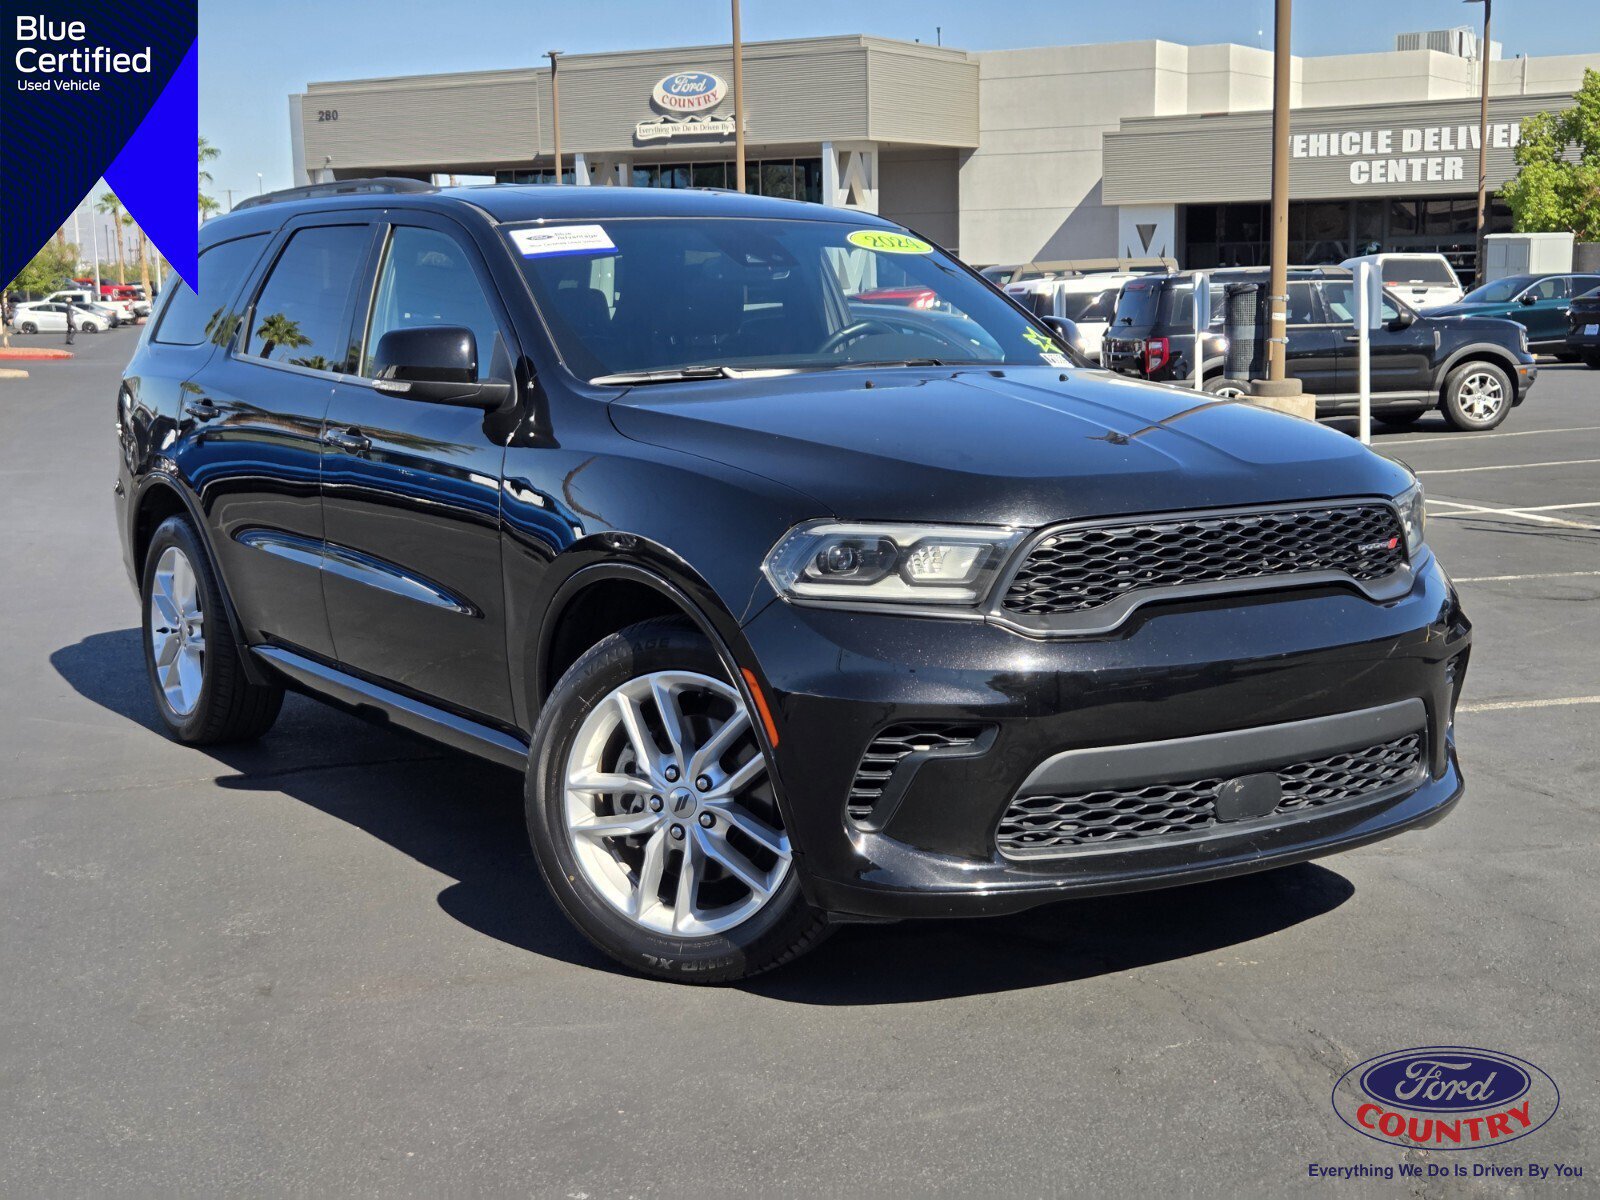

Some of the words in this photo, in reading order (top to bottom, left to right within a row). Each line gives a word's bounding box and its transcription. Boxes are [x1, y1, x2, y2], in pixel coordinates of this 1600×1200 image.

[671, 74, 707, 93] Ford
[661, 90, 719, 108] COUNTRY
[318, 109, 339, 122] 280
[639, 125, 670, 137] Everything
[671, 124, 681, 132] We
[682, 124, 692, 132] Do
[700, 123, 720, 132] Driven
[721, 122, 730, 132] By
[1289, 130, 1393, 158] EHICLE
[1350, 156, 1464, 185] CENTER
